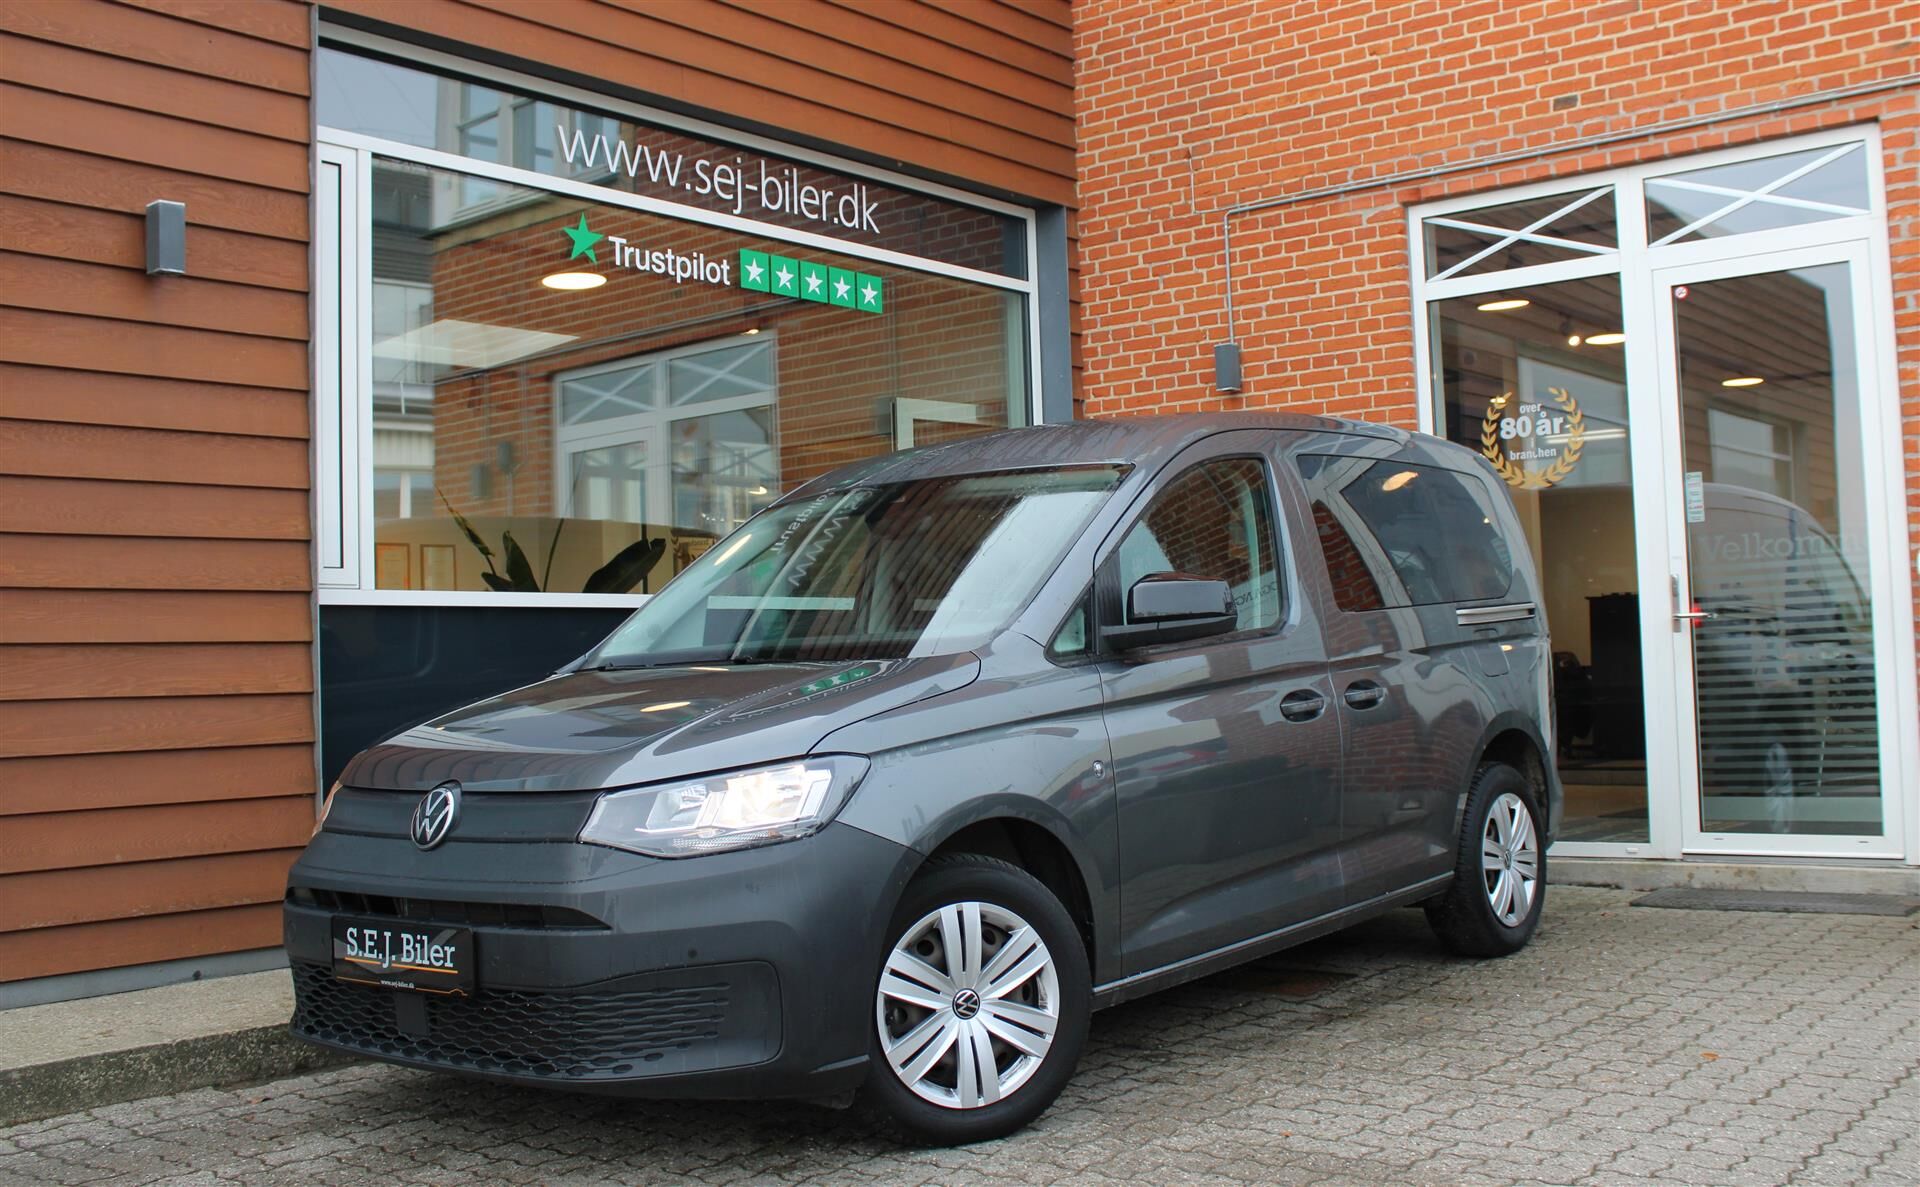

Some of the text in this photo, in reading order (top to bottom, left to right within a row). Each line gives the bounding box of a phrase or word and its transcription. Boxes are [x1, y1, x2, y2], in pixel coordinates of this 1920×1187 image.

[558, 124, 880, 234] www.sej-biler.dk
[608, 235, 731, 286] Trustpilot
[1500, 411, 1564, 440] 80 år
[1520, 403, 1541, 413] over
[347, 927, 456, 968] S.E.J. Biler
